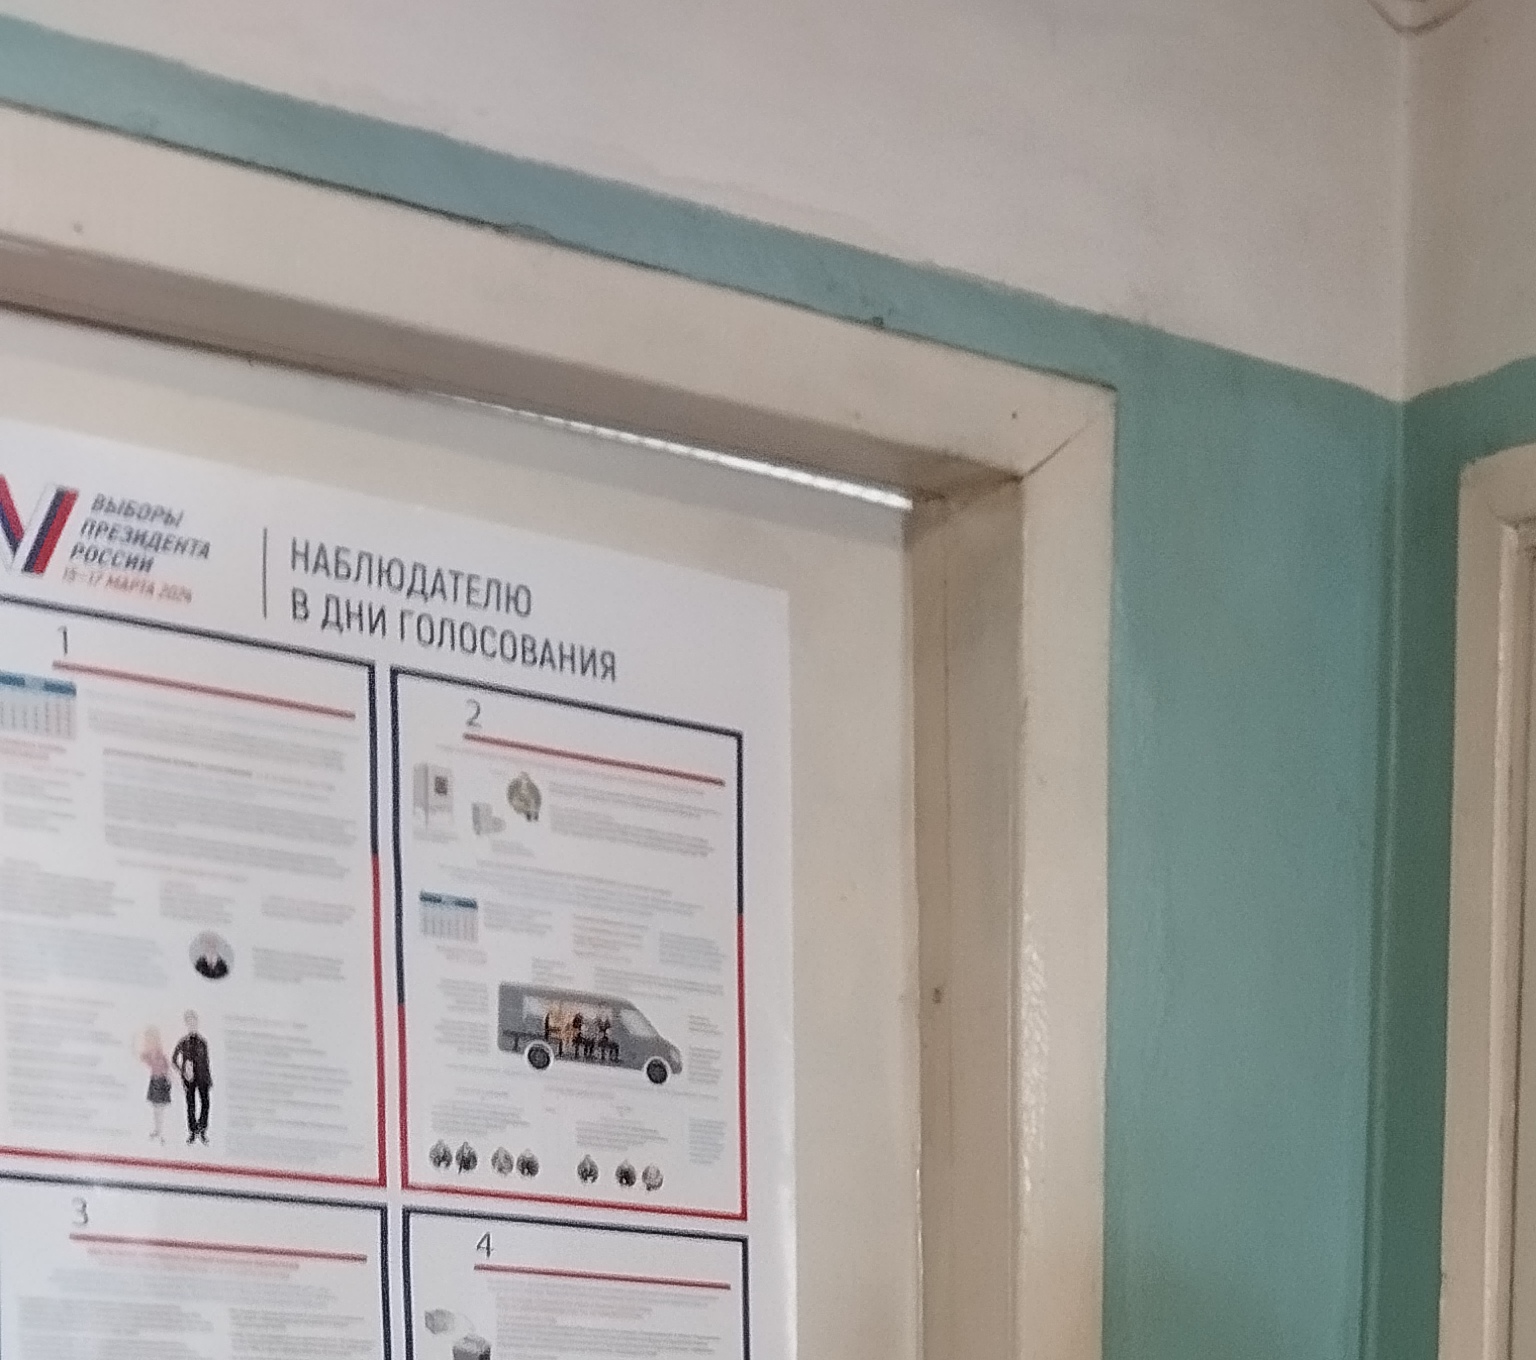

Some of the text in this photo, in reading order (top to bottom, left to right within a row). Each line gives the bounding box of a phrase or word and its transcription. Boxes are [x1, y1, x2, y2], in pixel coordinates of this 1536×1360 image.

[91, 493, 184, 528] ВЫБОРЫ
[81, 517, 211, 560] ПРЕЗИДЕНТА
[70, 541, 155, 573] РОССИИ
[291, 536, 533, 618] НАБЛЮДАТЕЛЮ
[57, 624, 68, 657] 1
[291, 586, 617, 683] В ДНИ ГОЛОСОВАНИЯ
[465, 698, 482, 730] 2
[72, 1197, 89, 1228] 3
[475, 1231, 494, 1259] 4
